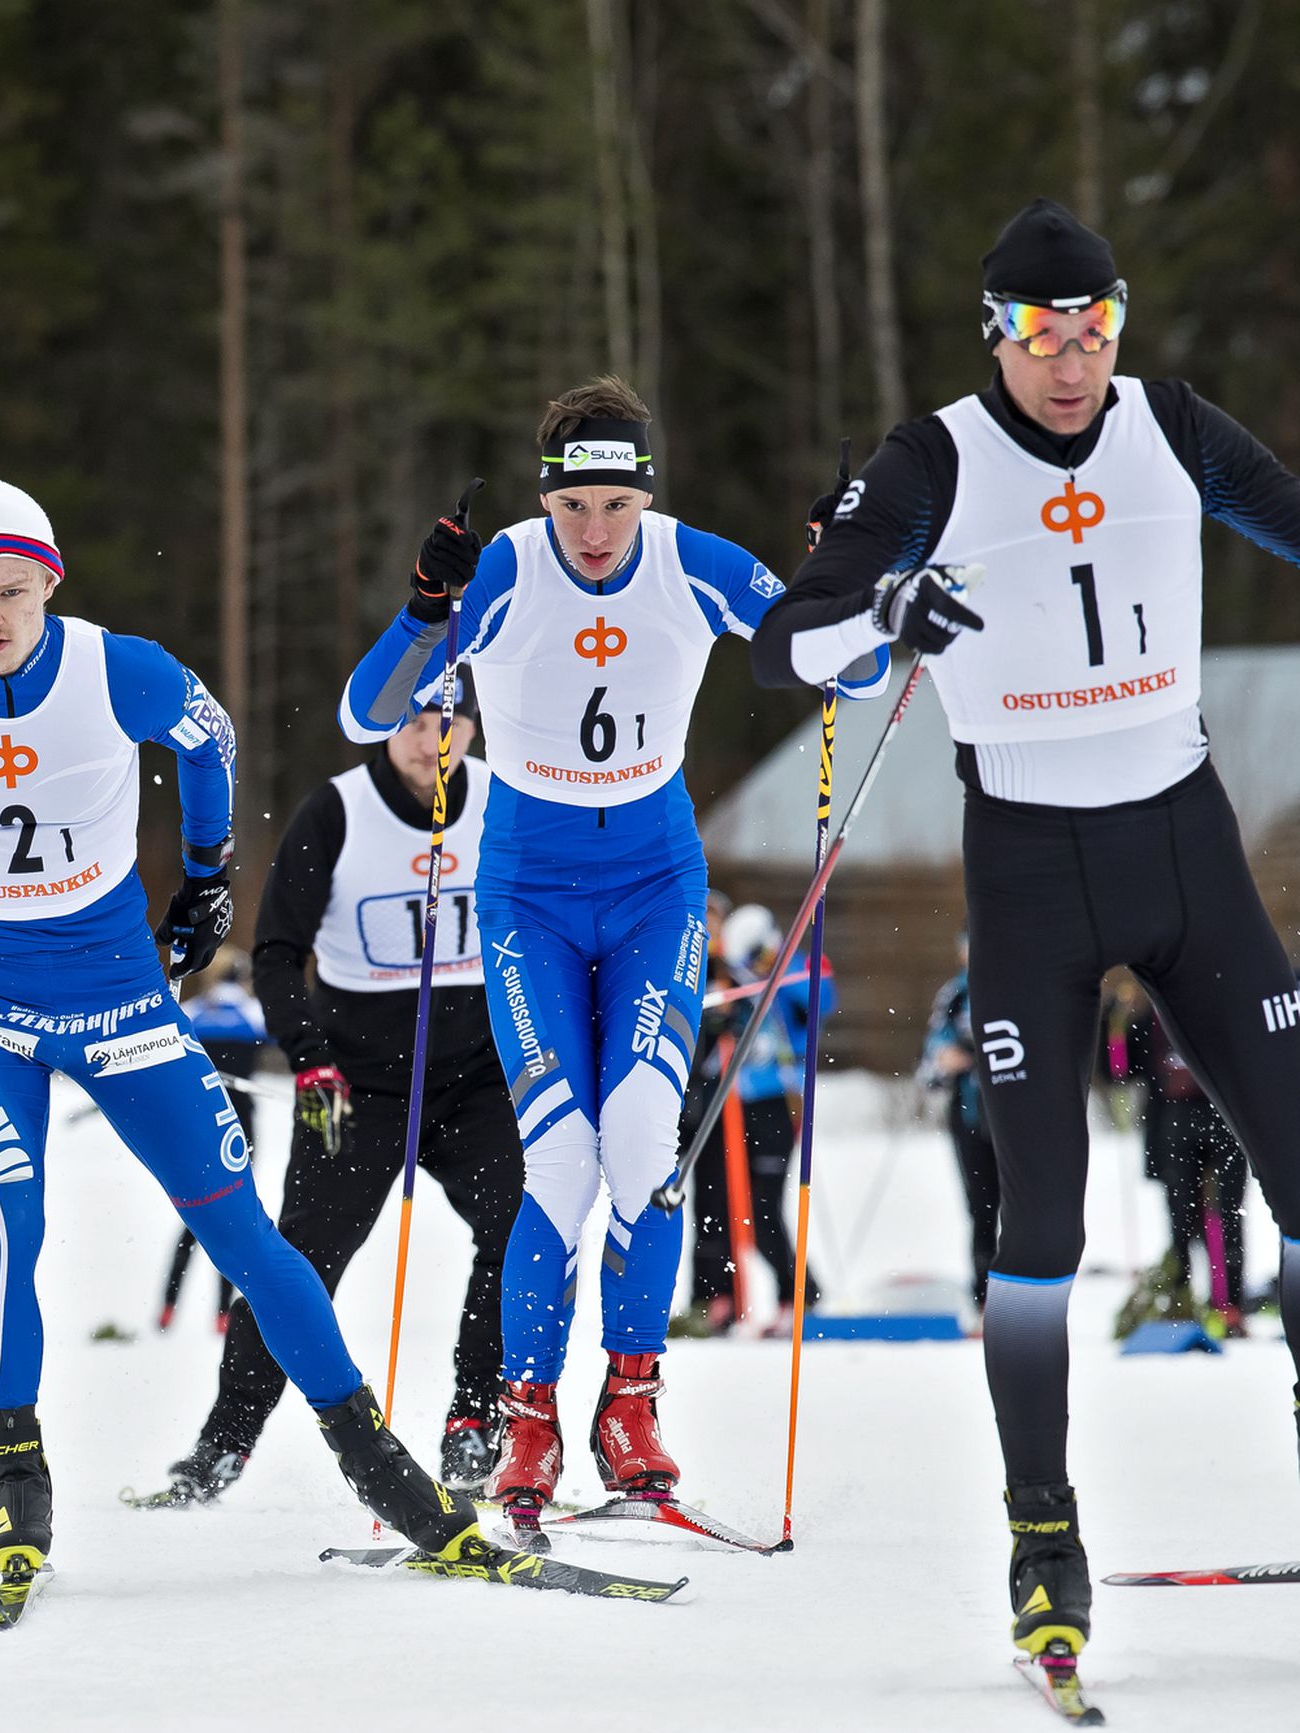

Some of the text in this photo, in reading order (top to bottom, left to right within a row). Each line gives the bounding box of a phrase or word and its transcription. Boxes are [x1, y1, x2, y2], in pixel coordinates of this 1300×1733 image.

[1070, 563, 1146, 667] 1 1
[1003, 667, 1176, 710] OSUUSPANKKI
[580, 686, 645, 762] 6 1
[525, 756, 662, 784] OSUUSPANKKI
[0, 805, 75, 873] 2 1
[112, 1036, 179, 1060] LÄHITAPIOLA
[618, 1381, 657, 1395] alpina
[509, 1401, 550, 1420] alpina
[606, 1417, 632, 1453] alpina
